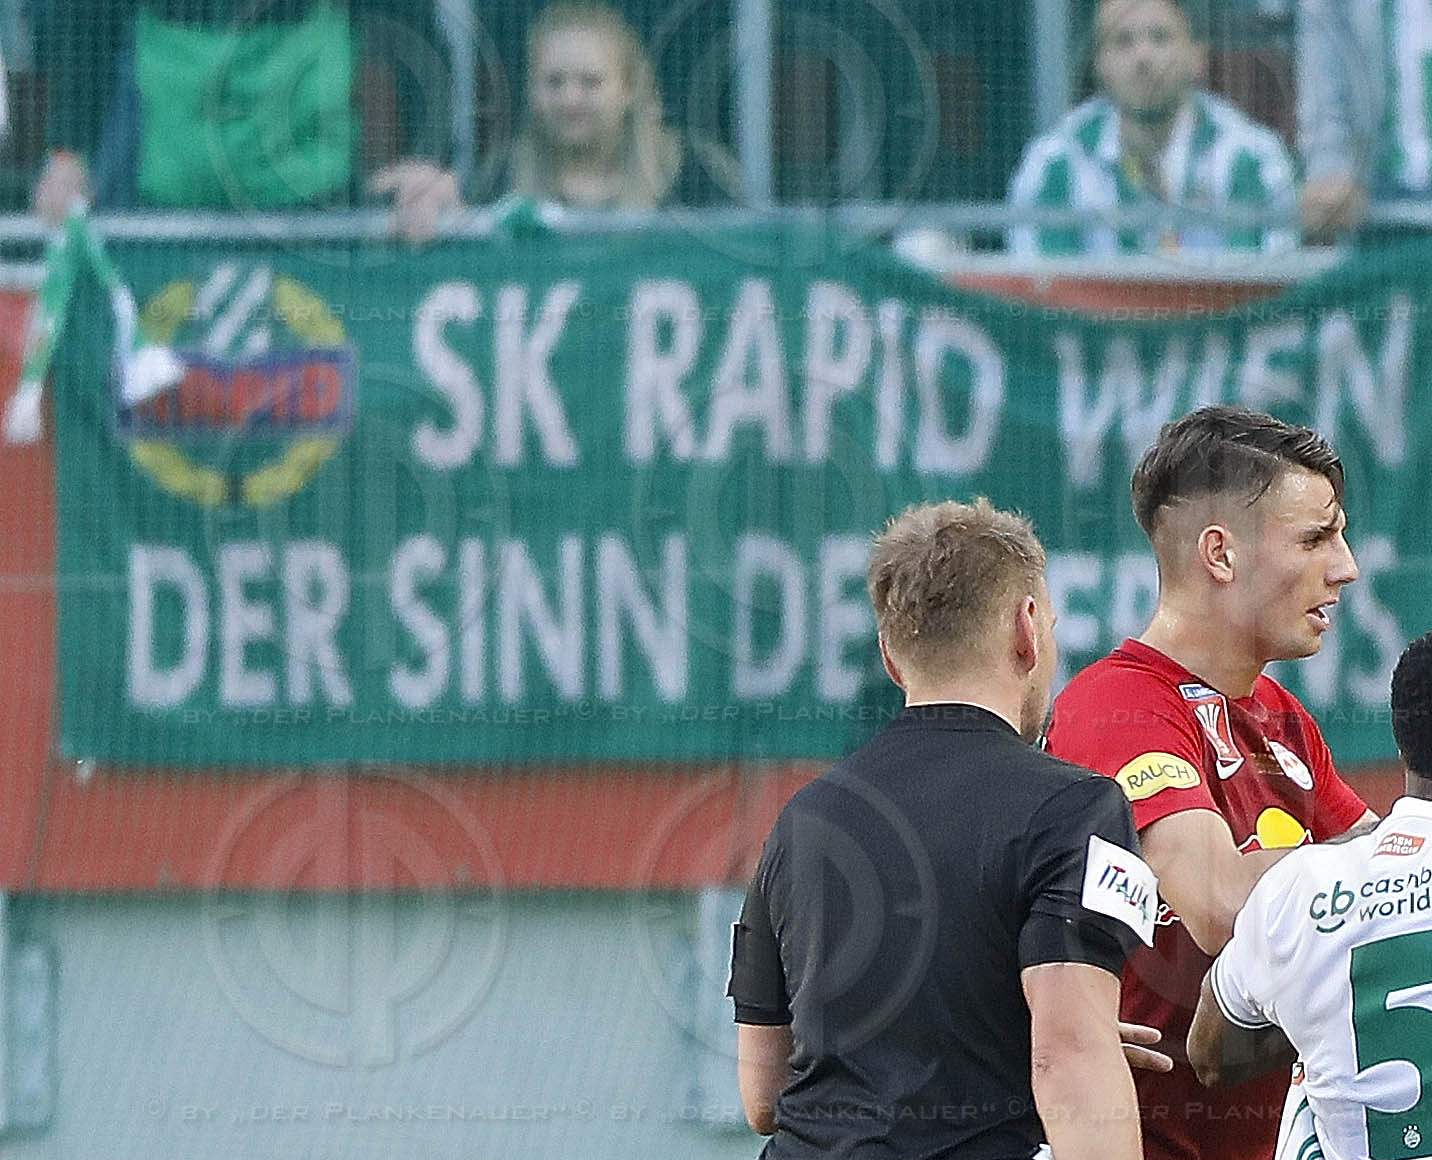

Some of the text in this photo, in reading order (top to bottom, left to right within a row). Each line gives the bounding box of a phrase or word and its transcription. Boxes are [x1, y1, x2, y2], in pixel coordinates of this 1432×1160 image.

[410, 278, 581, 470] SK
[622, 277, 1006, 475] RAPID
[127, 538, 355, 710] DER
[388, 534, 690, 709] SINN
[731, 533, 873, 702] DE
[1126, 763, 1191, 790] RAUCH
[1359, 887, 1431, 922] world
